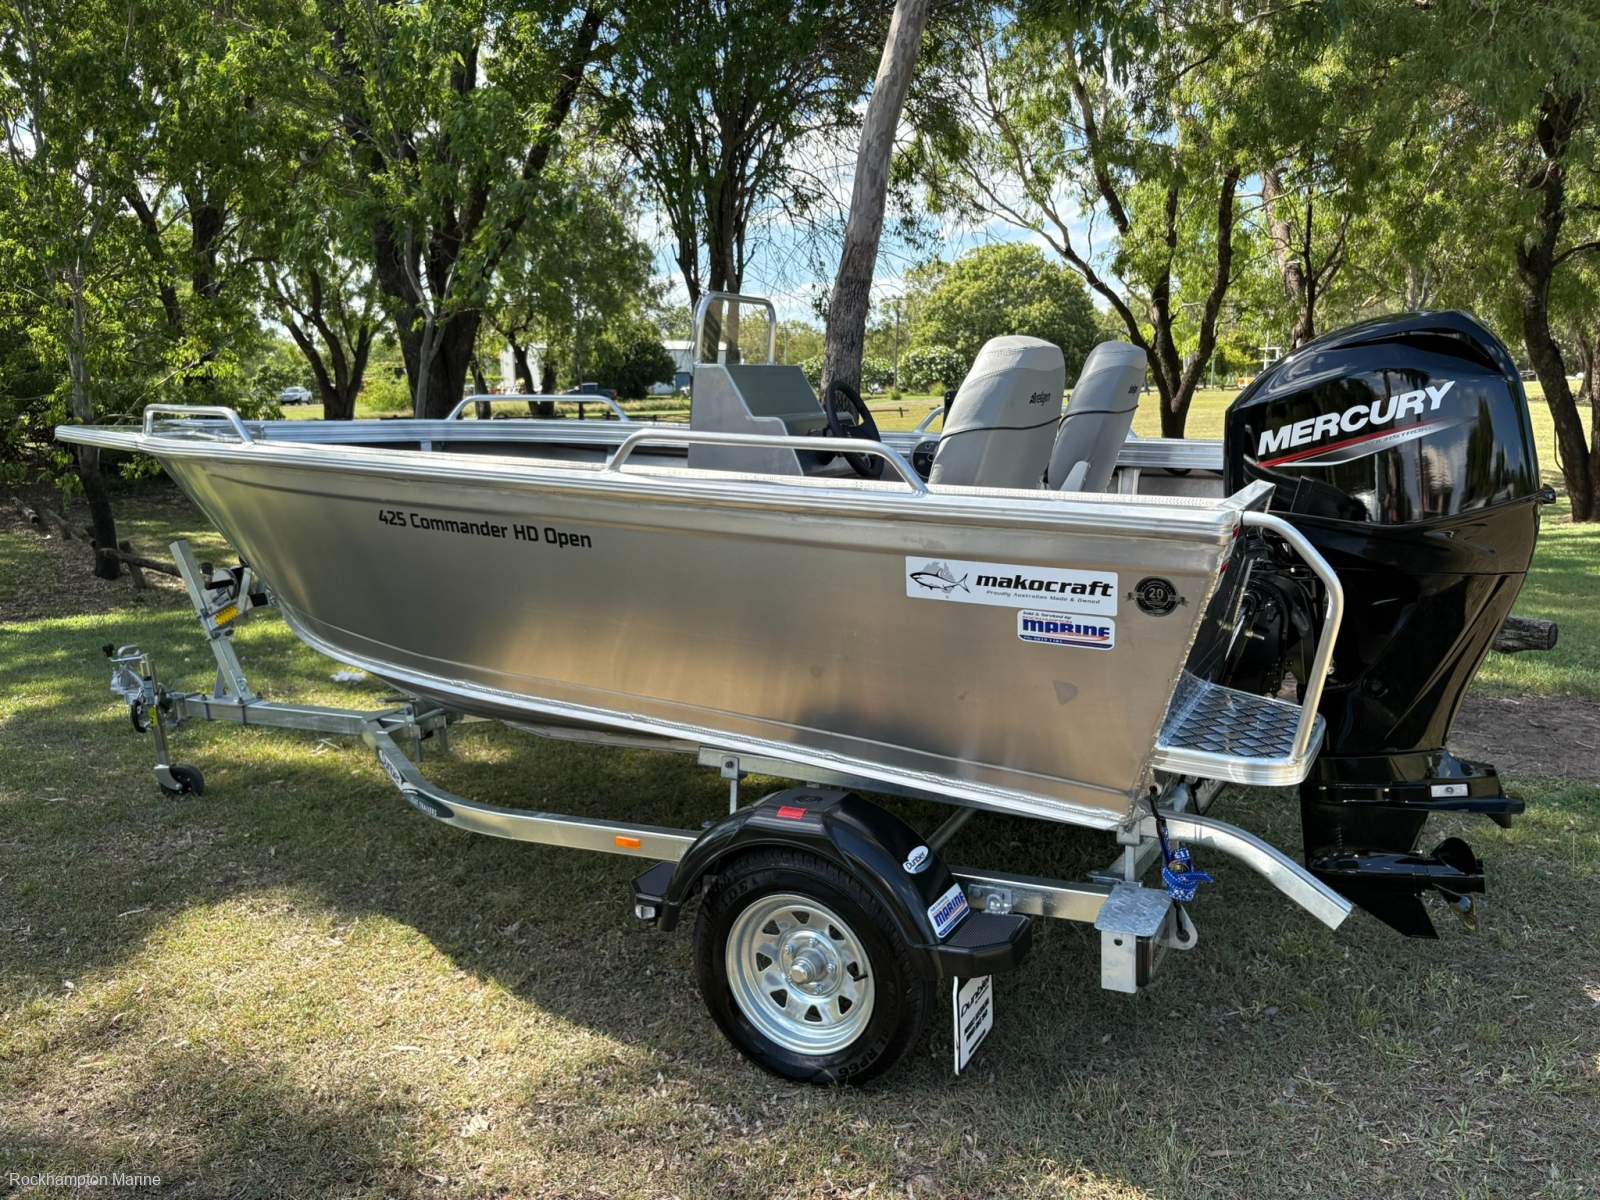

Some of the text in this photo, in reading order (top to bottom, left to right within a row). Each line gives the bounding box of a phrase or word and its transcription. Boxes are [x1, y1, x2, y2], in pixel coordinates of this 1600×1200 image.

[1257, 381, 1456, 456] MERCURY
[378, 509, 592, 549] 425 Commander HD Open
[976, 575, 1114, 597] makocraft
[1148, 588, 1164, 600] 20
[1022, 619, 1111, 638] MARINE
[933, 891, 965, 927] MARINE
